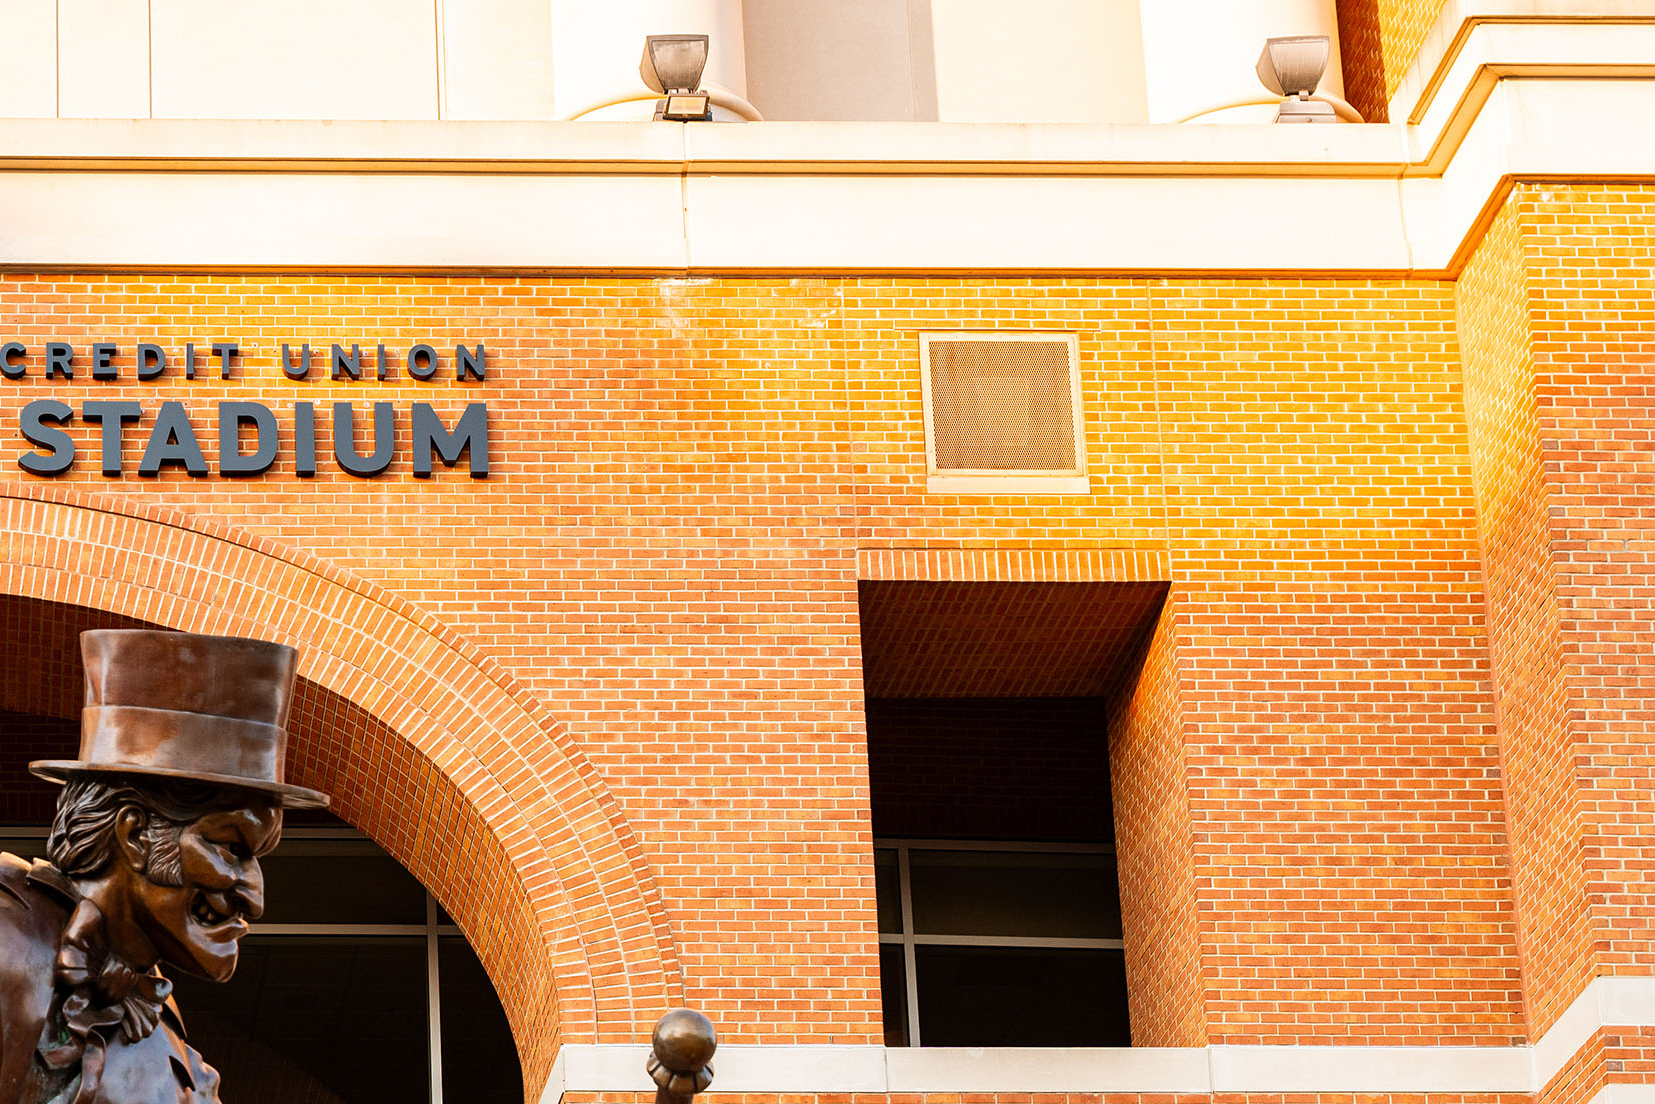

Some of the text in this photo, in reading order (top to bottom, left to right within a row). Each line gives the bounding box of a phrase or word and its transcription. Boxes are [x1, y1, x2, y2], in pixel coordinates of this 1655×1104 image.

[0, 342, 238, 380] CREDIT
[282, 343, 486, 382] UNION
[18, 400, 489, 478] STADIUM
